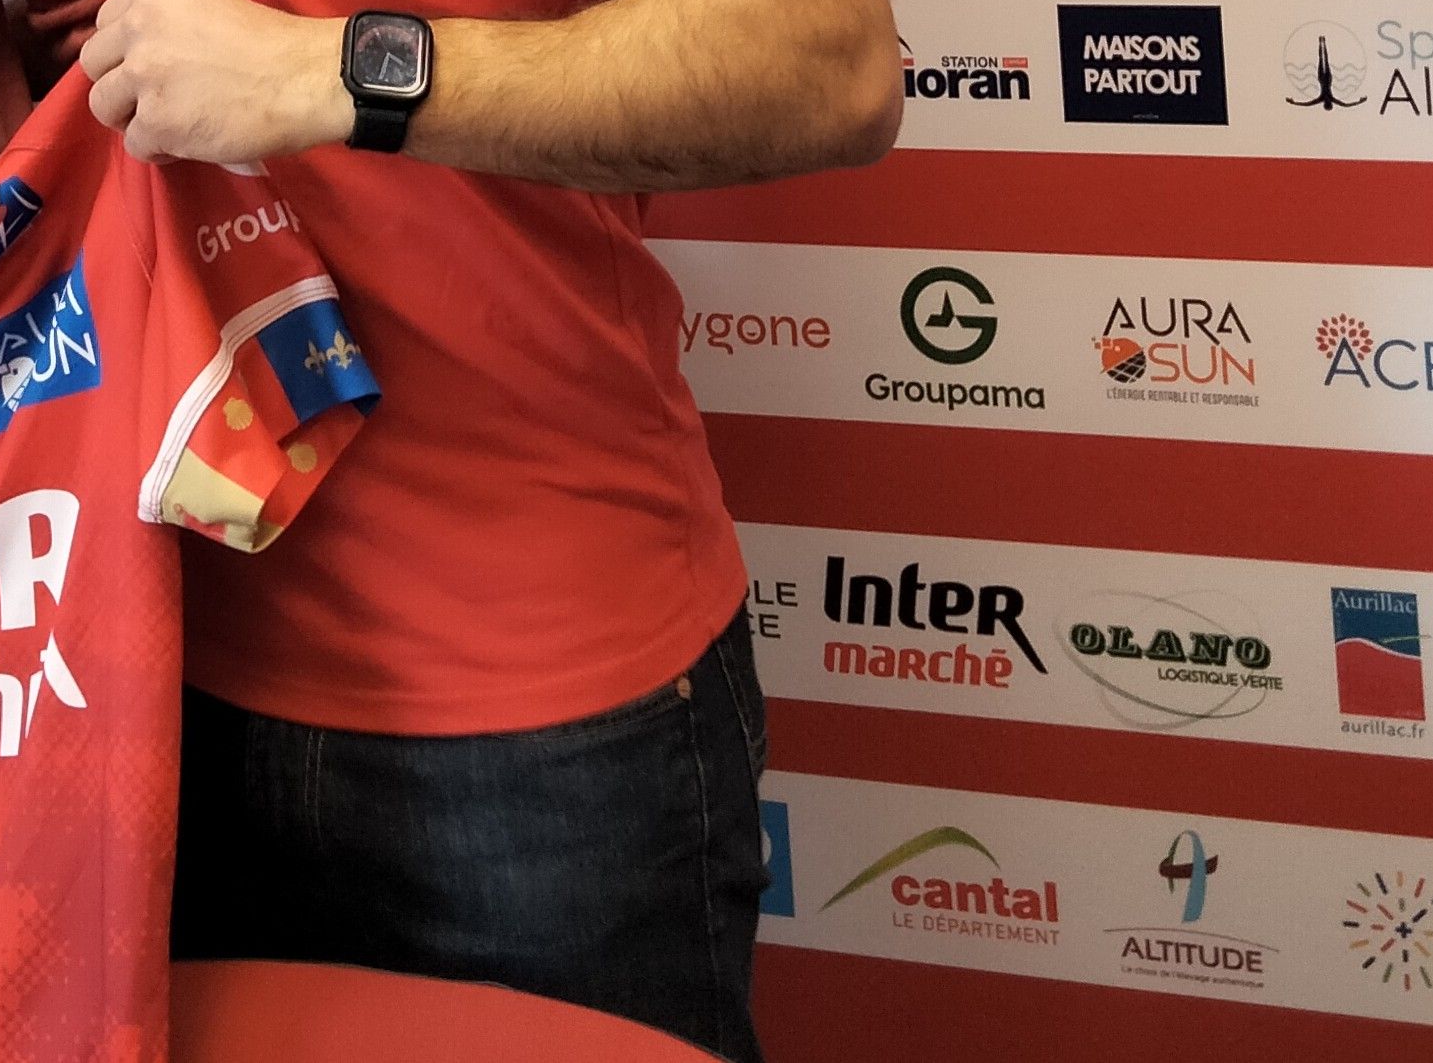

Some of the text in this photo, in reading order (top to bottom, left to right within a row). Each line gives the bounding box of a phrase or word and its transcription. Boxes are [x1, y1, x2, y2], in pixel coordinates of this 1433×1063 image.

[941, 56, 998, 68] STATION
[1083, 34, 1200, 62] MAISONS
[1377, 20, 1433, 70] Sp
[905, 58, 1031, 101] ioran
[1084, 68, 1201, 95] PARTOUT
[680, 312, 831, 355] ygone
[1102, 296, 1251, 346] AURA
[1147, 343, 1256, 386] SUN
[865, 373, 1045, 410] Groupama
[1333, 589, 1416, 615] Aurillac
[1070, 623, 1271, 670] OLANO
[1158, 667, 1283, 690] LOGISTIQUE VERTE
[1341, 719, 1425, 740] aurillac.fr
[891, 875, 1059, 922] cantal
[892, 912, 1059, 945] LE DÉPARTEMENT
[1121, 936, 1264, 973] ALTITUDE
